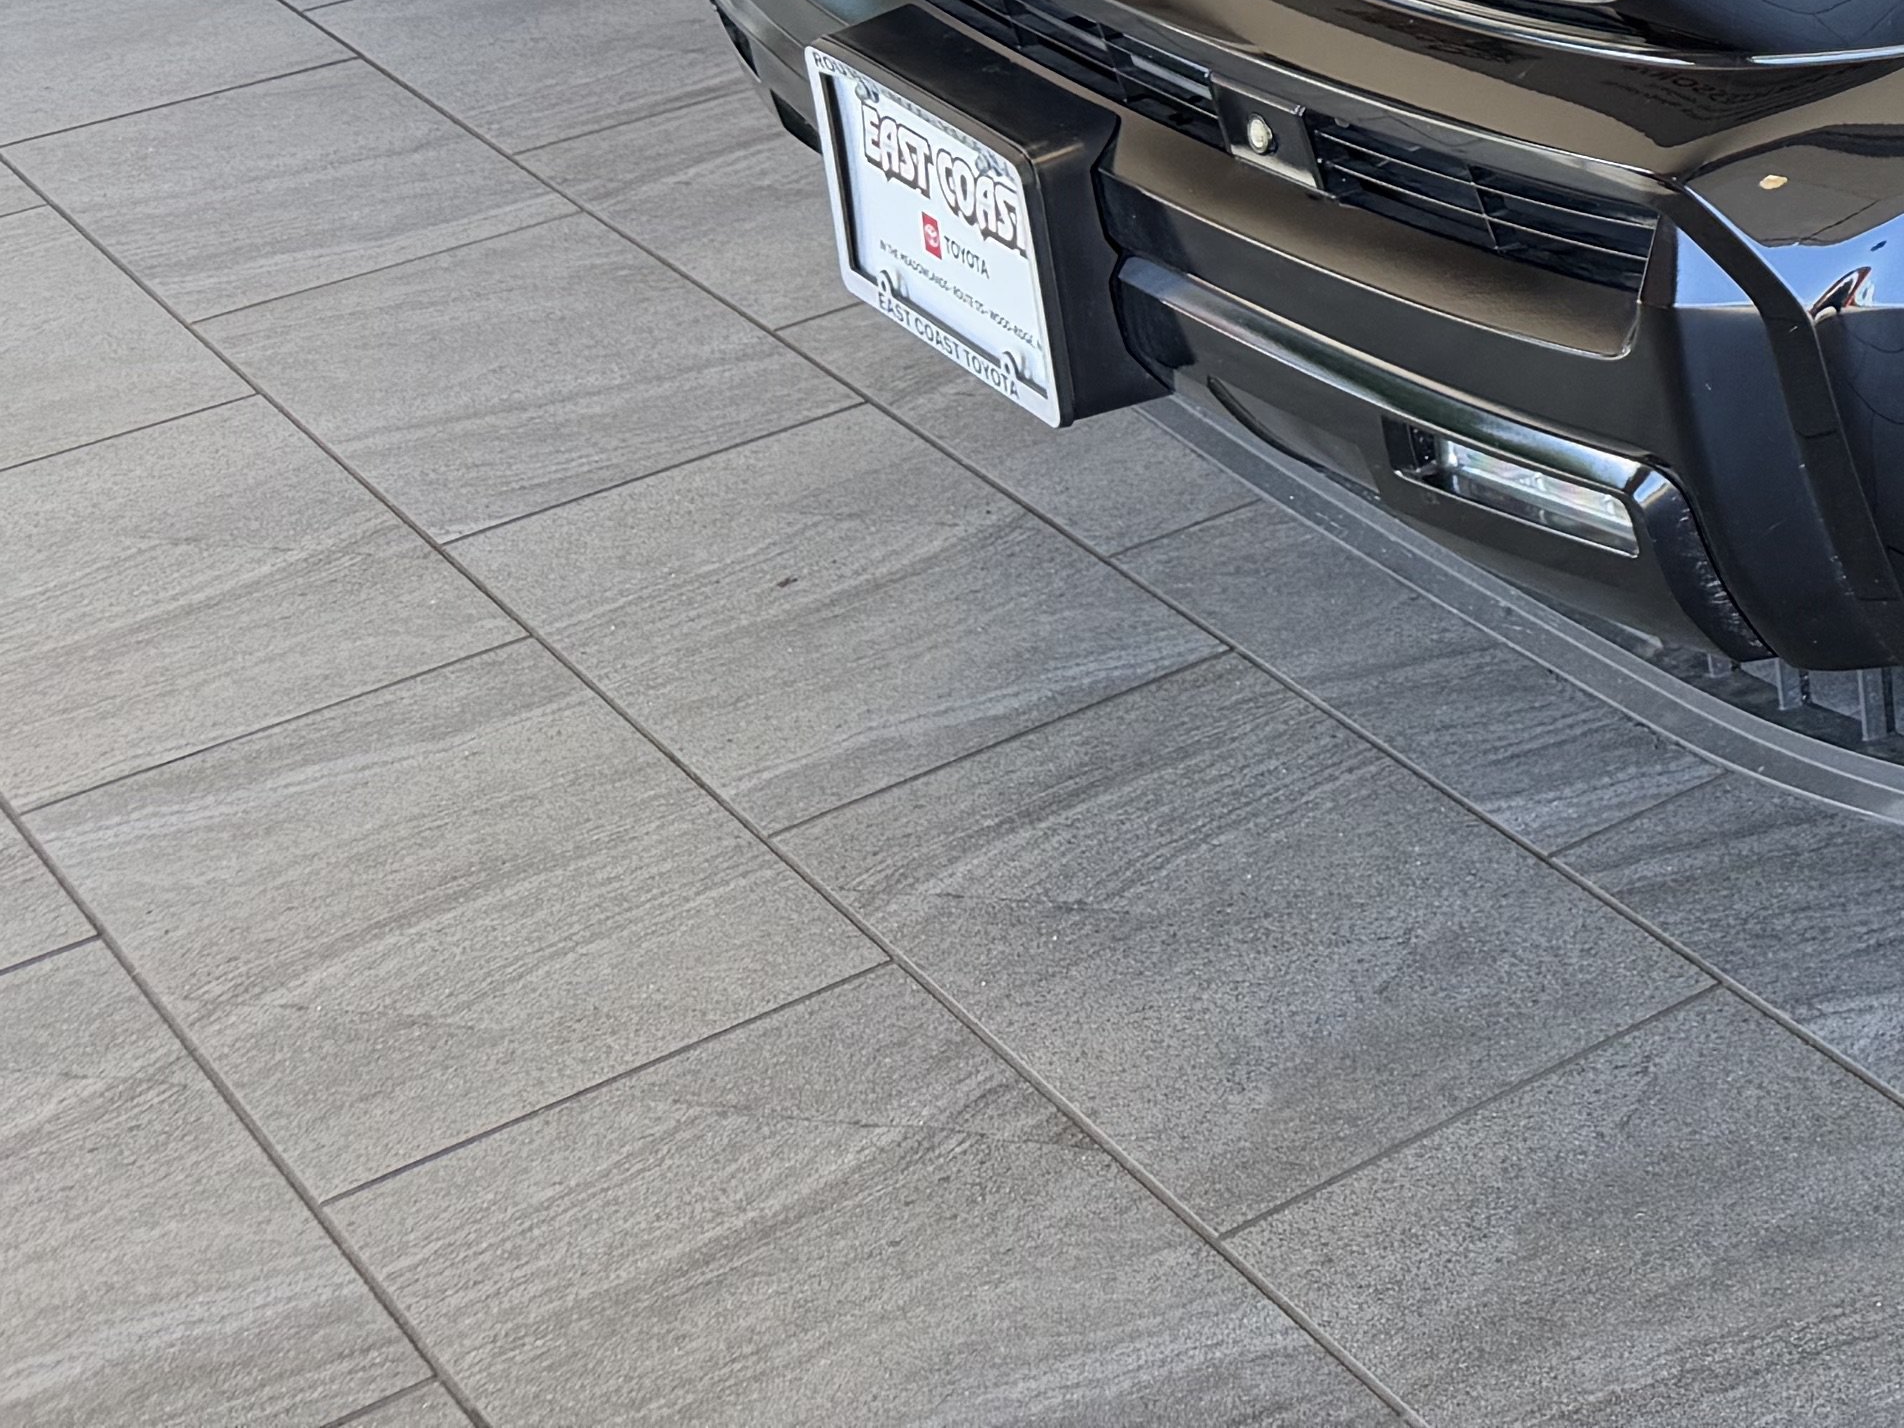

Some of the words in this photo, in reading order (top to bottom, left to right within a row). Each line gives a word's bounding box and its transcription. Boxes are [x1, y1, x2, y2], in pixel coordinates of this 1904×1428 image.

[861, 103, 933, 199] EAST
[936, 148, 1028, 259] COAST
[944, 235, 989, 280] TOYOTA
[878, 292, 912, 325] EAST
[915, 316, 960, 360] COAST
[963, 349, 1020, 400] TOYOTA
